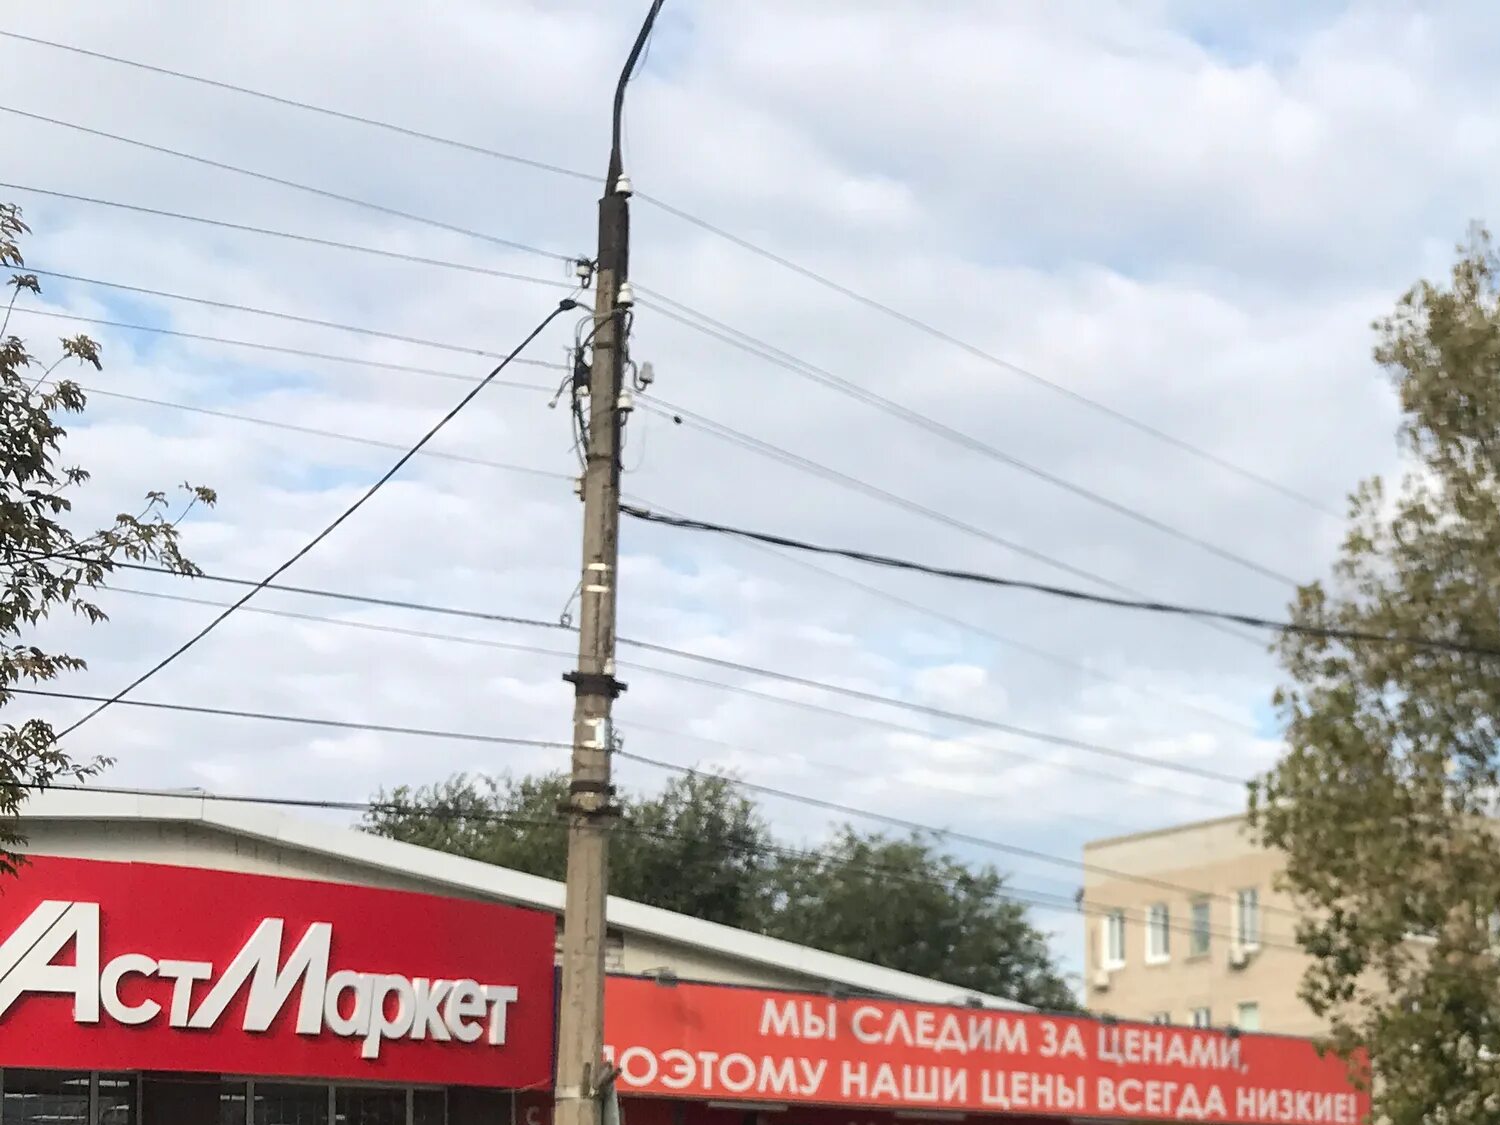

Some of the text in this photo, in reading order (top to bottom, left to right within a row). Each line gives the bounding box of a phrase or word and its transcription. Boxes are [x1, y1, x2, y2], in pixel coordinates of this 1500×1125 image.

[0, 899, 518, 1059] АстМаркет
[760, 998, 1249, 1075] МЫ СЛЕДИМ ЗА ЦЕНАМИ,
[841, 1059, 968, 1102] НАШИ
[981, 1069, 1085, 1112] ЦЕНЫ
[1098, 1076, 1227, 1120] ВСЕГДА
[1235, 1086, 1358, 1125] НИЗКИЕ!
